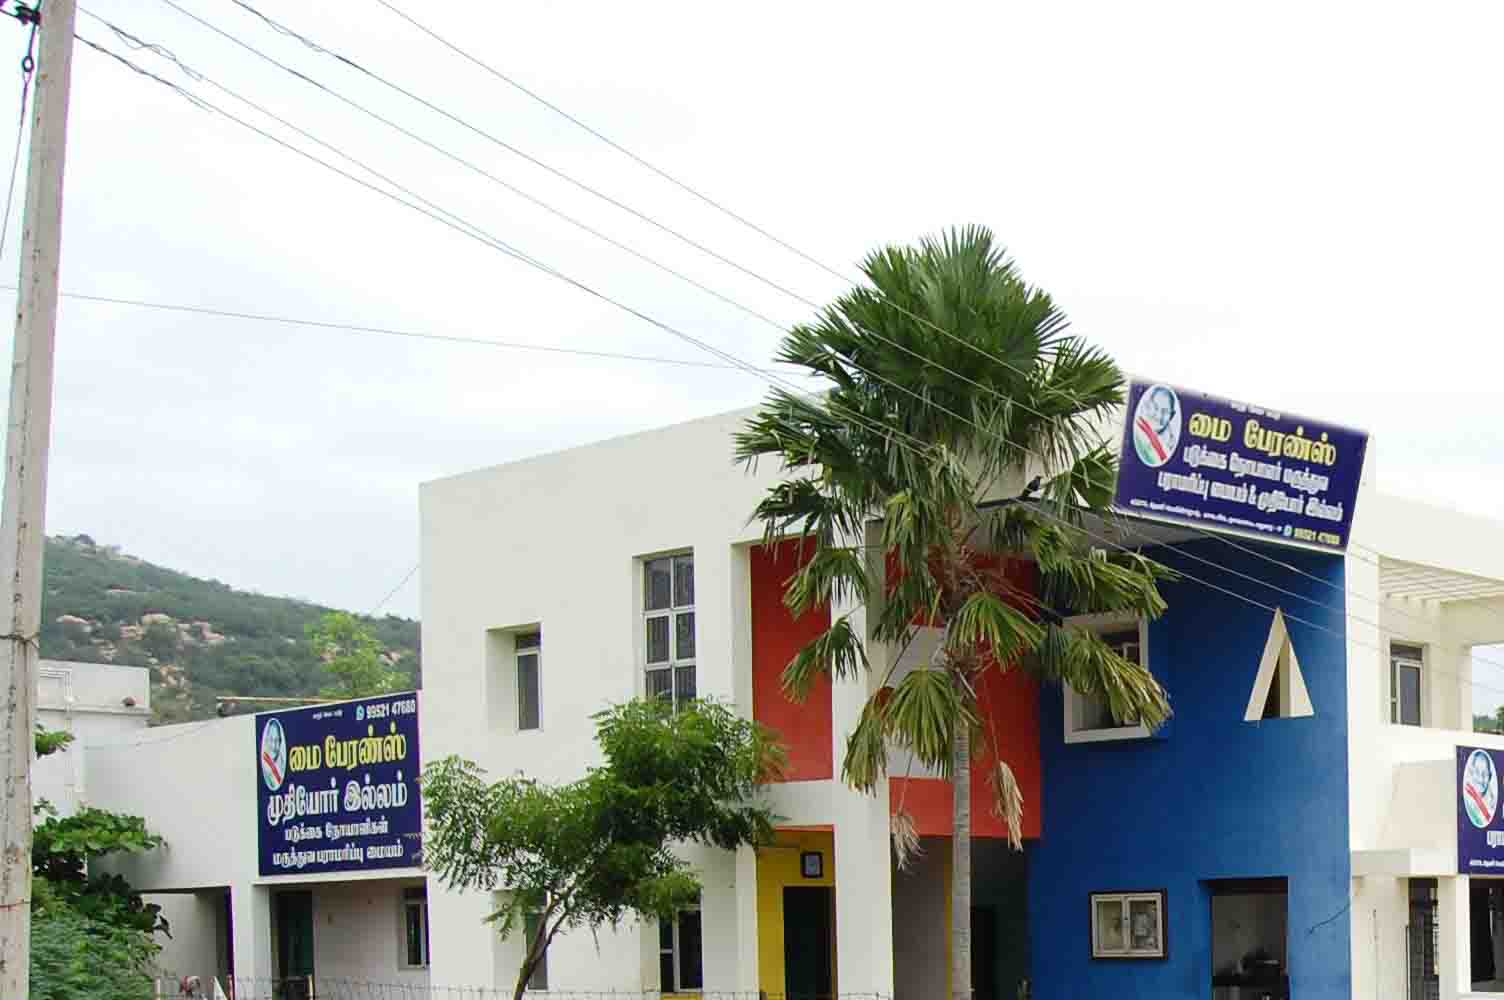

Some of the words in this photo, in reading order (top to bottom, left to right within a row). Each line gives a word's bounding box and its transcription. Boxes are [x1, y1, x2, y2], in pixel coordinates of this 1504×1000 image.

[1188, 412, 1232, 441] மை
[289, 745, 321, 772] மை
[324, 721, 407, 770] பேரண்ஸ்
[267, 777, 339, 826] முதியோர்
[343, 770, 408, 812] இல்லம்
